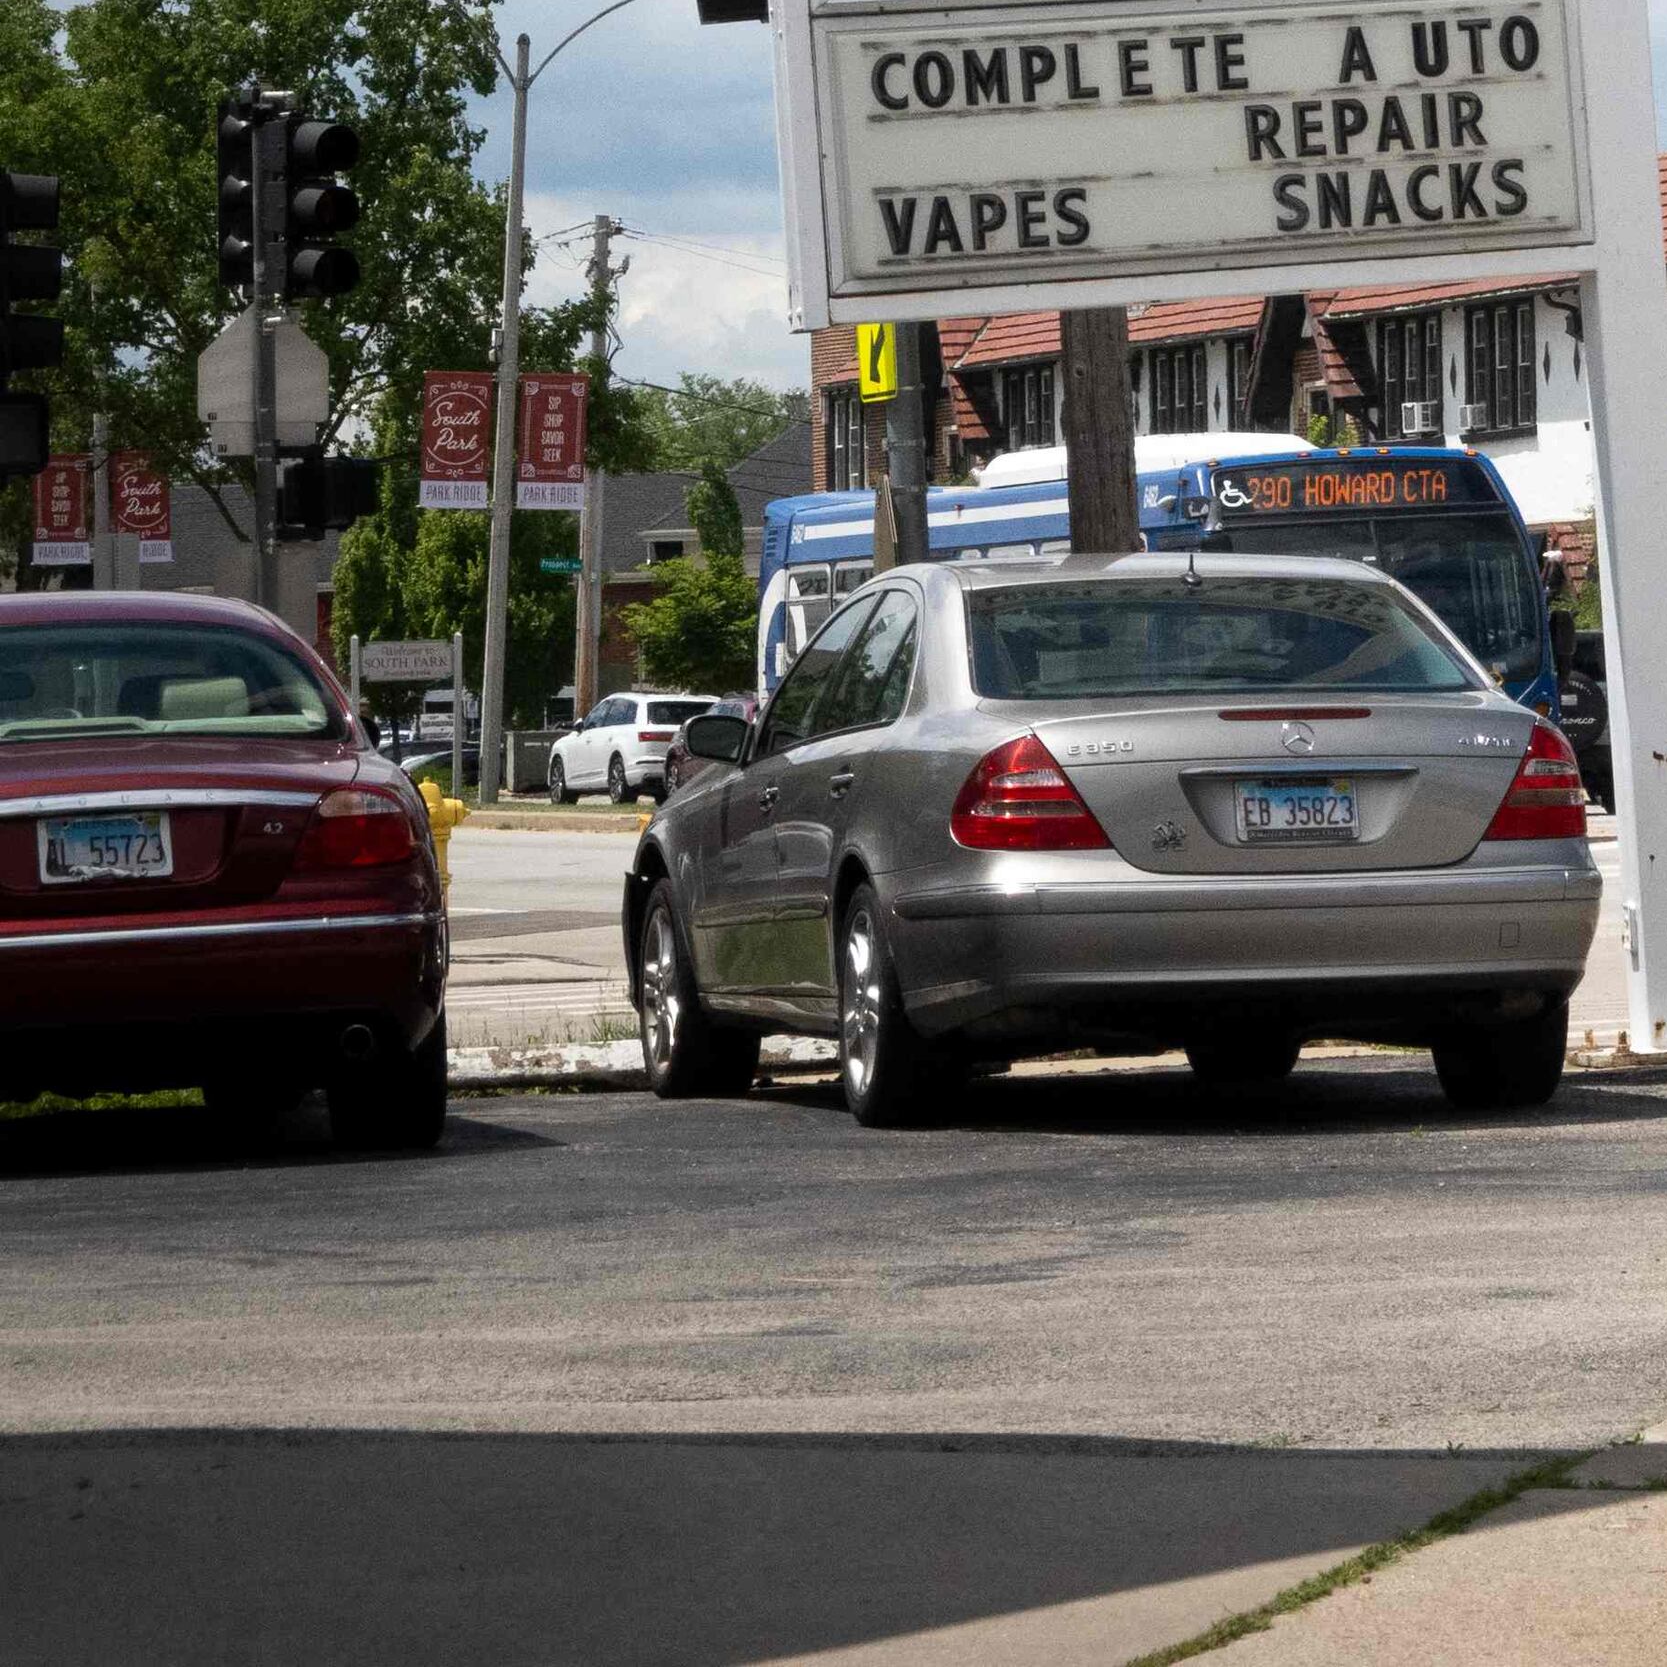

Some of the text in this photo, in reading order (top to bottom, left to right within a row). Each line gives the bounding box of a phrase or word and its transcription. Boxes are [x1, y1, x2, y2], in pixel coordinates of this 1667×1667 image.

[870, 33, 1250, 113] COMPLETE
[1244, 91, 1489, 162] REPAIR
[880, 158, 1529, 256] VAPES SNACKS
[431, 401, 481, 427] South
[548, 396, 562, 410] SIP
[543, 413, 564, 428] SHOP
[433, 428, 480, 452] Park
[541, 430, 565, 446] SAVOR
[543, 447, 562, 463] SEEK
[120, 476, 162, 498] South
[425, 485, 450, 501] PARK
[523, 487, 548, 503] PARK
[1305, 471, 1396, 506] HOWARD
[1402, 470, 1448, 503] CTA
[123, 497, 162, 518] Park
[364, 654, 449, 670] SOUTH PARK
[1243, 794, 1354, 826] EB 35823
[89, 833, 165, 867] 55723
